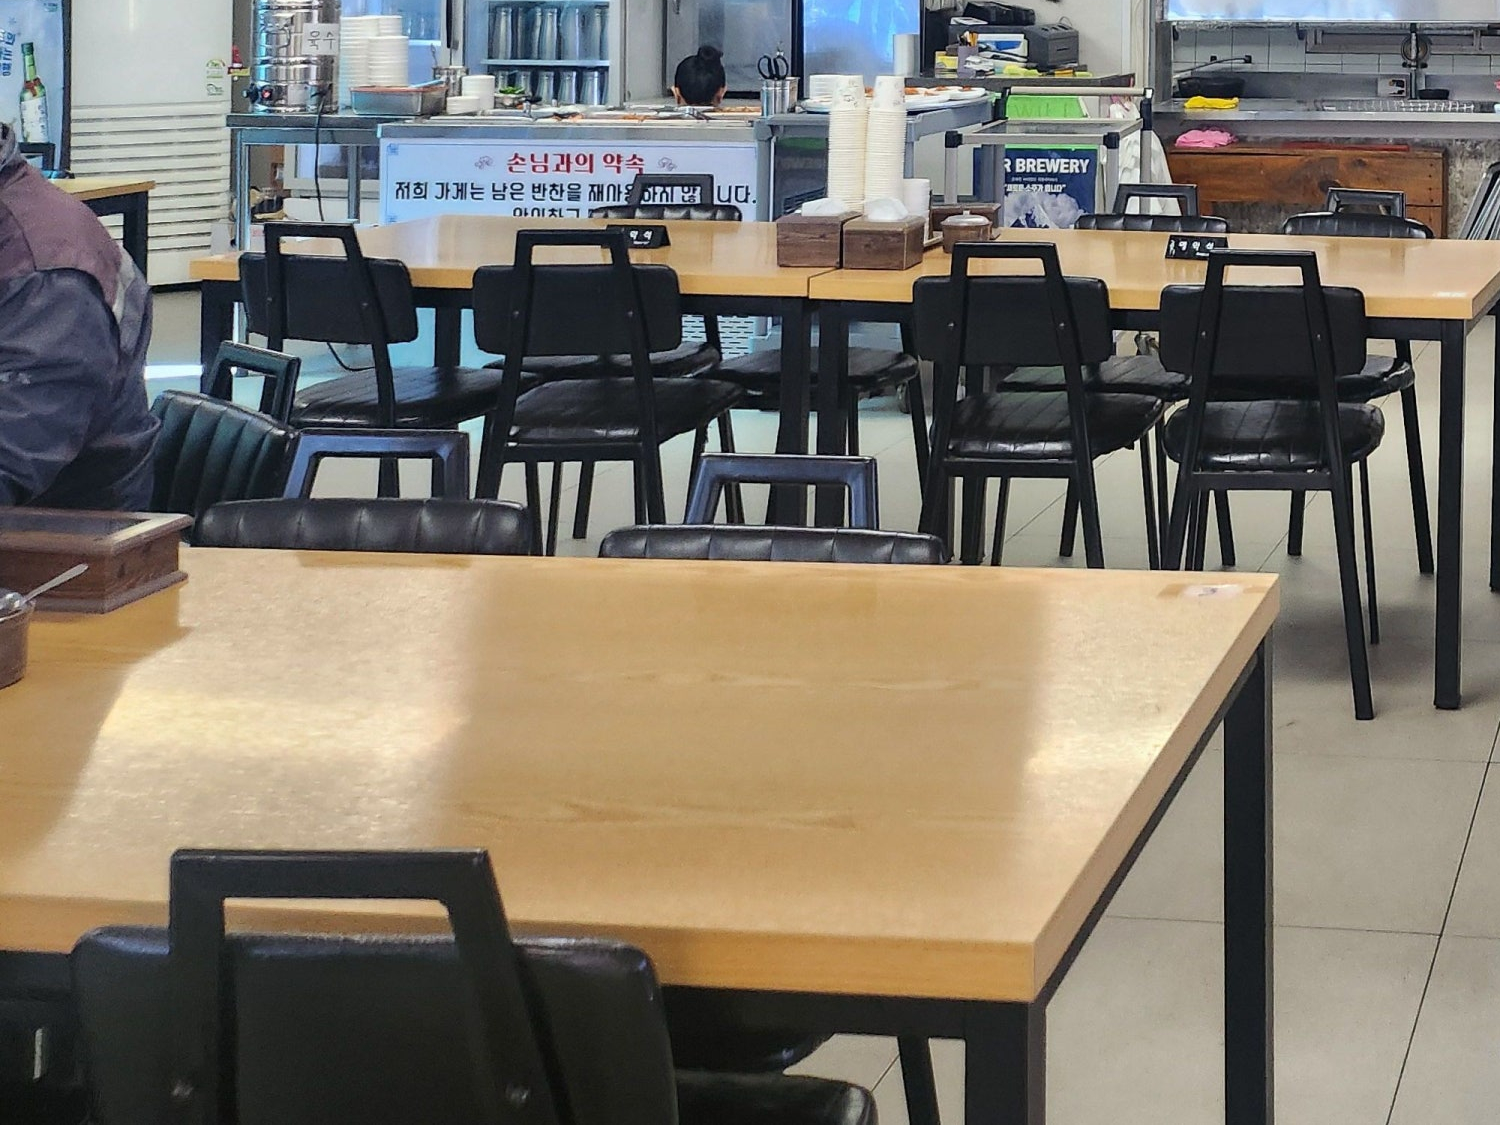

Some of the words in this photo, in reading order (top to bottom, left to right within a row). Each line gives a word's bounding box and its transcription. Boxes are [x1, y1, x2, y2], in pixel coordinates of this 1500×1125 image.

[307, 31, 336, 51] 육수
[507, 152, 595, 174] 손님과의
[603, 152, 645, 175] 약속
[1015, 158, 1090, 173] BREWERY
[395, 181, 428, 201] 저희
[435, 182, 485, 201] 가게는
[491, 182, 525, 201] 남은
[531, 182, 581, 202] 반찬을
